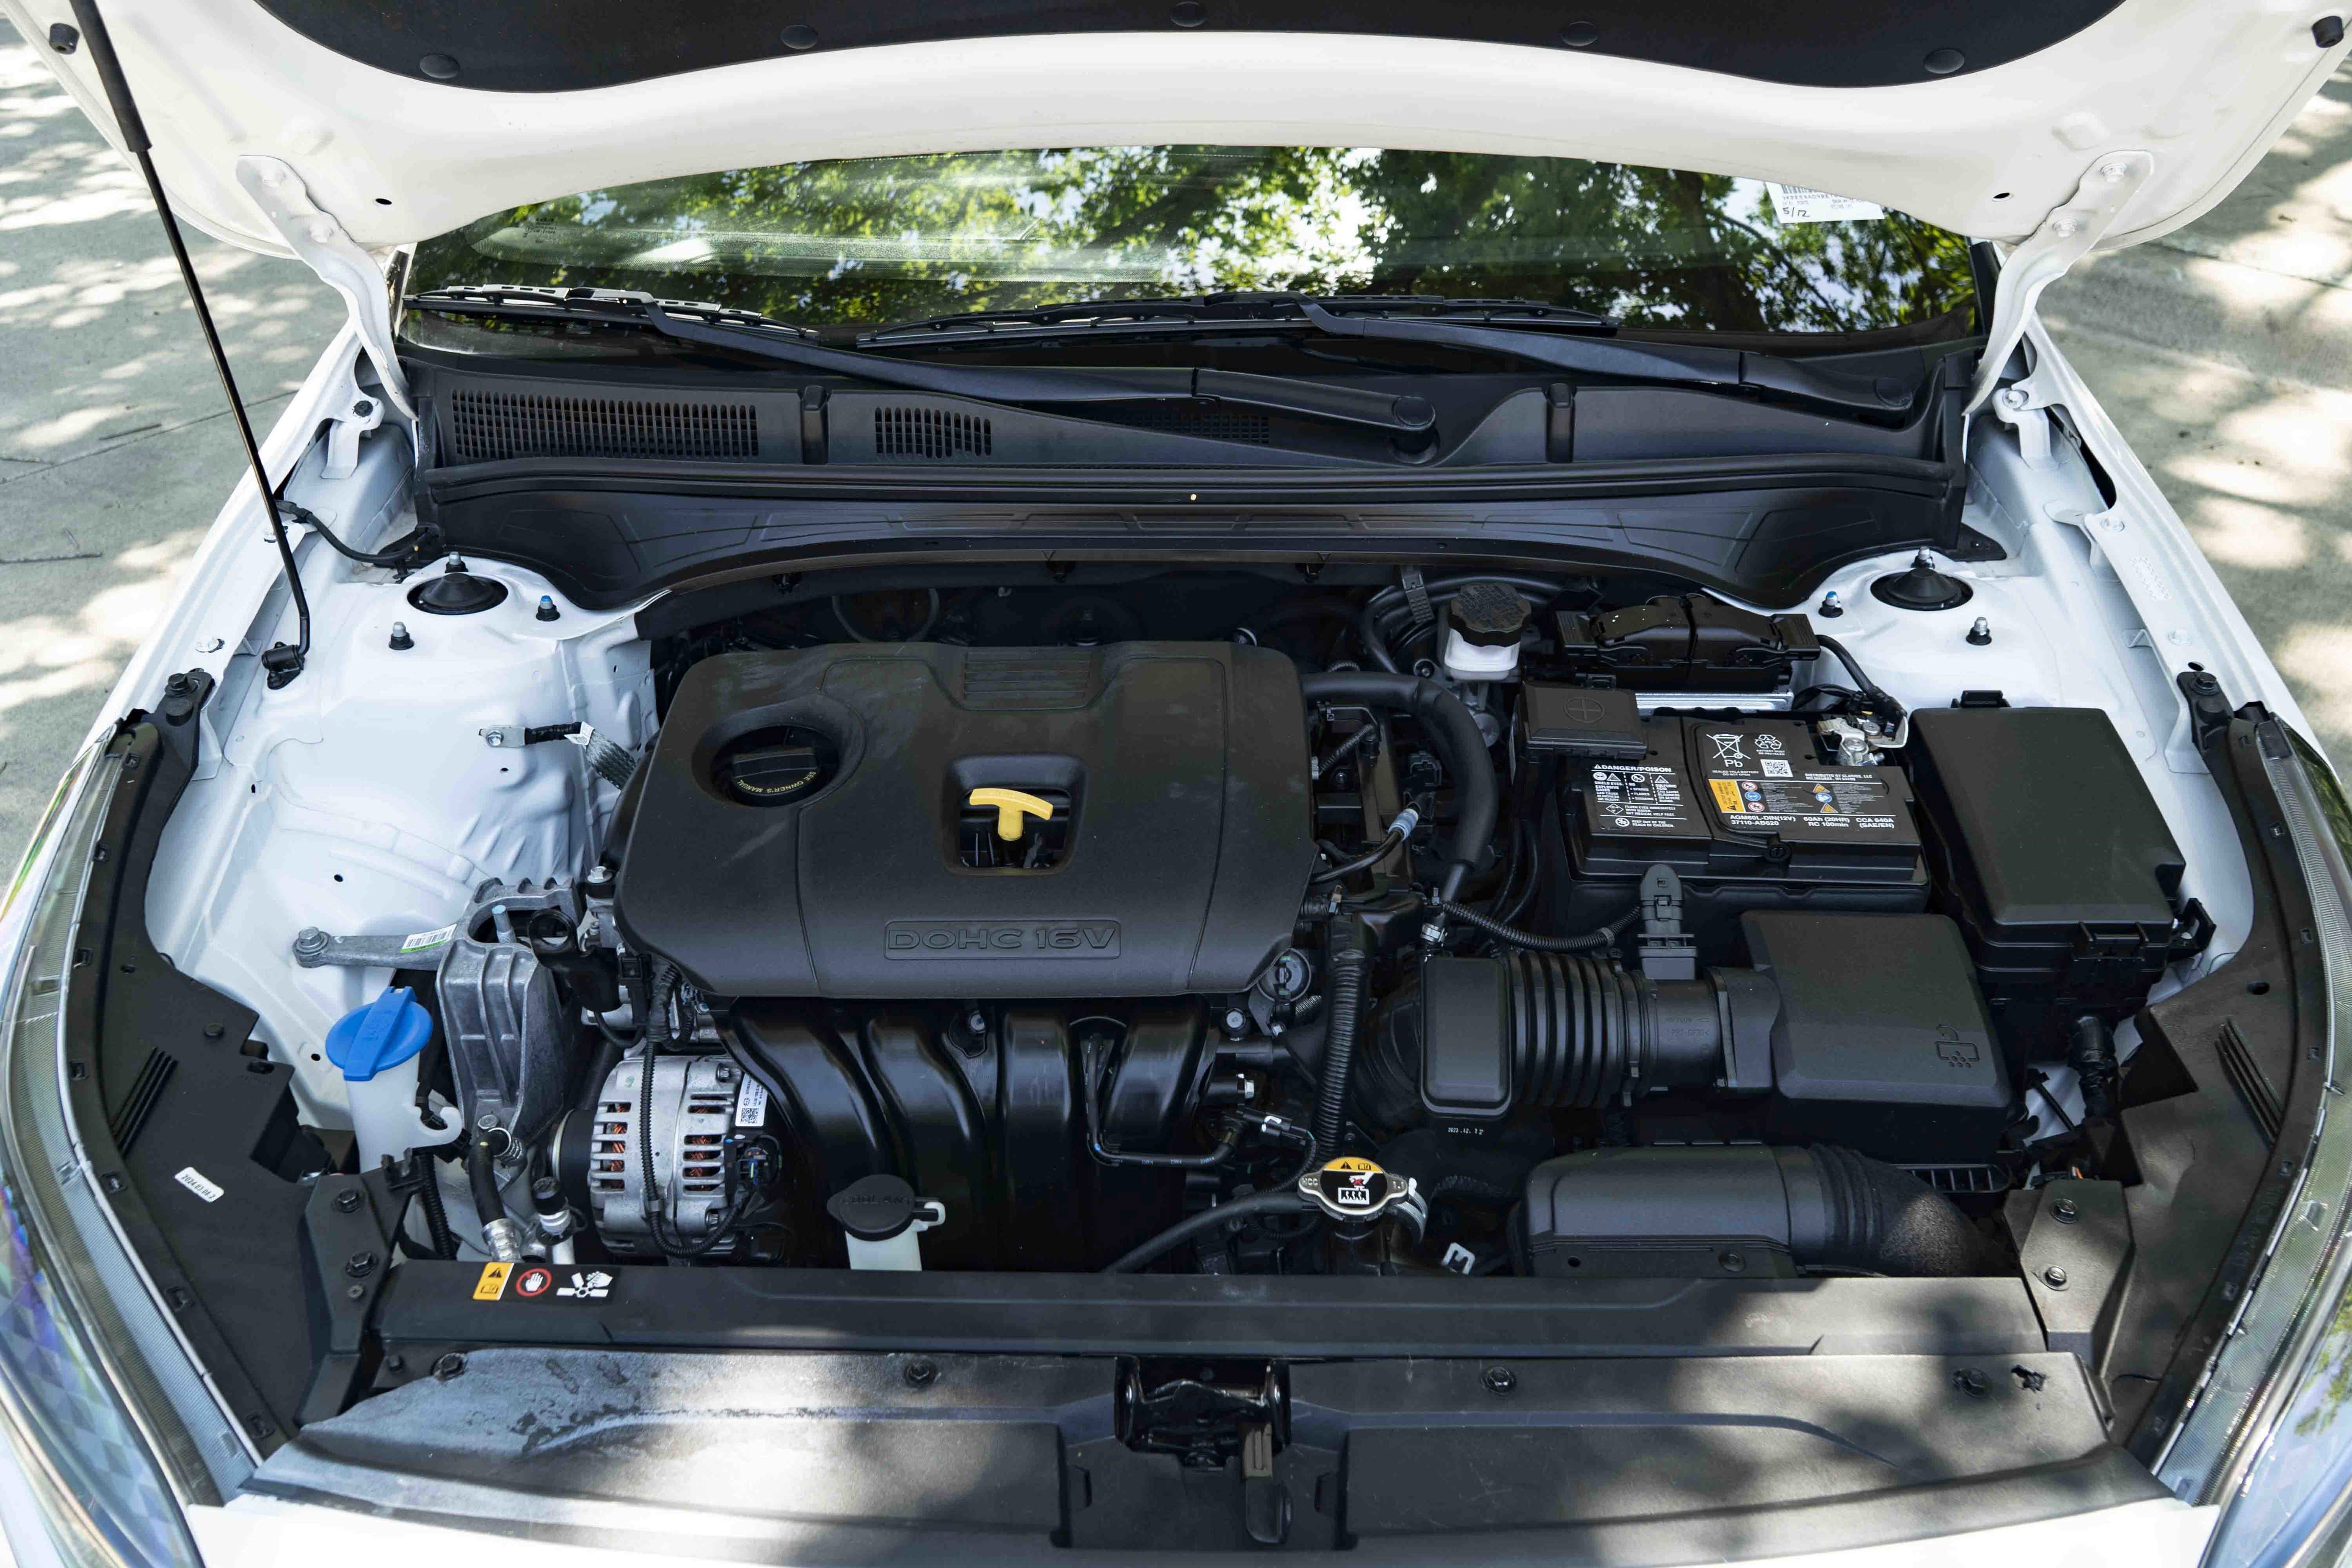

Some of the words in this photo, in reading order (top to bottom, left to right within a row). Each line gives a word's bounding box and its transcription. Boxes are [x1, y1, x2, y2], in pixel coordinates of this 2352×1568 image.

[1724, 760, 1743, 768] Pb
[803, 771, 816, 781] SEE
[737, 779, 764, 793] MANUAL
[766, 780, 804, 793] OWNER'S
[888, 928, 1023, 950] DOHC
[1036, 928, 1117, 949] 16V
